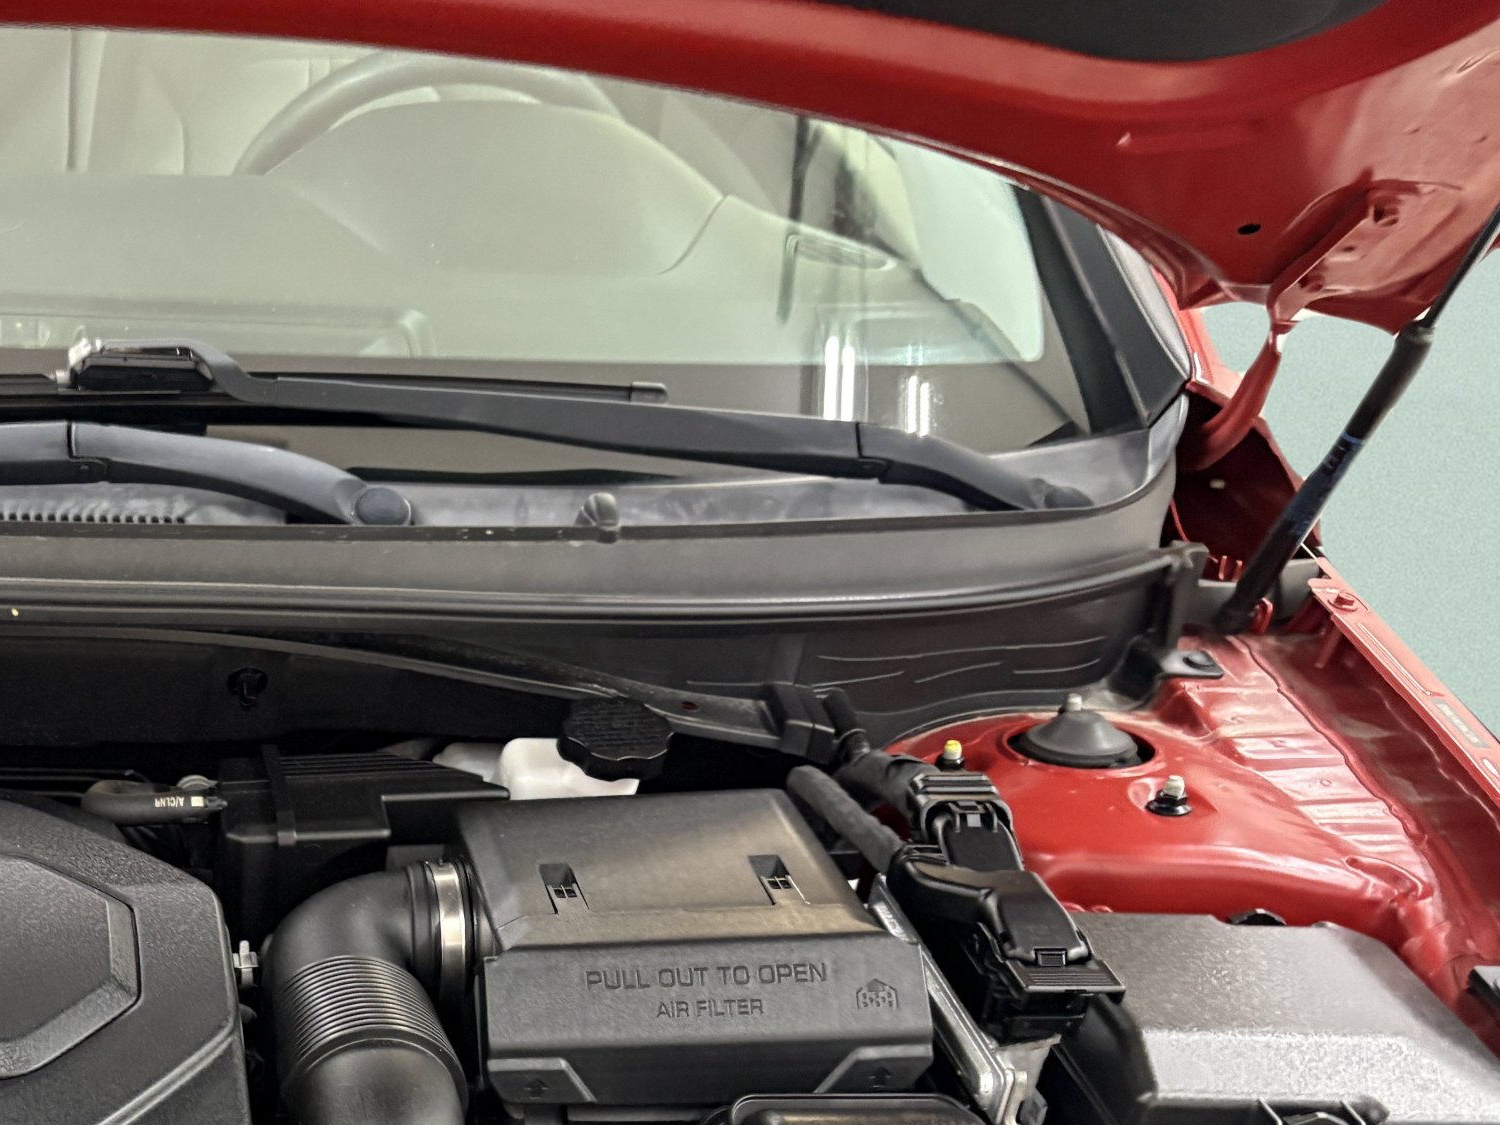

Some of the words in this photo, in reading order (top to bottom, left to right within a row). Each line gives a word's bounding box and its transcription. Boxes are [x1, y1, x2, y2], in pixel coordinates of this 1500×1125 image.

[586, 969, 650, 989] PULL
[658, 967, 708, 988] OUT
[717, 966, 750, 986] TO
[758, 962, 827, 984] OPEN
[656, 1000, 690, 1018] AIR
[697, 999, 763, 1017] FILTER
